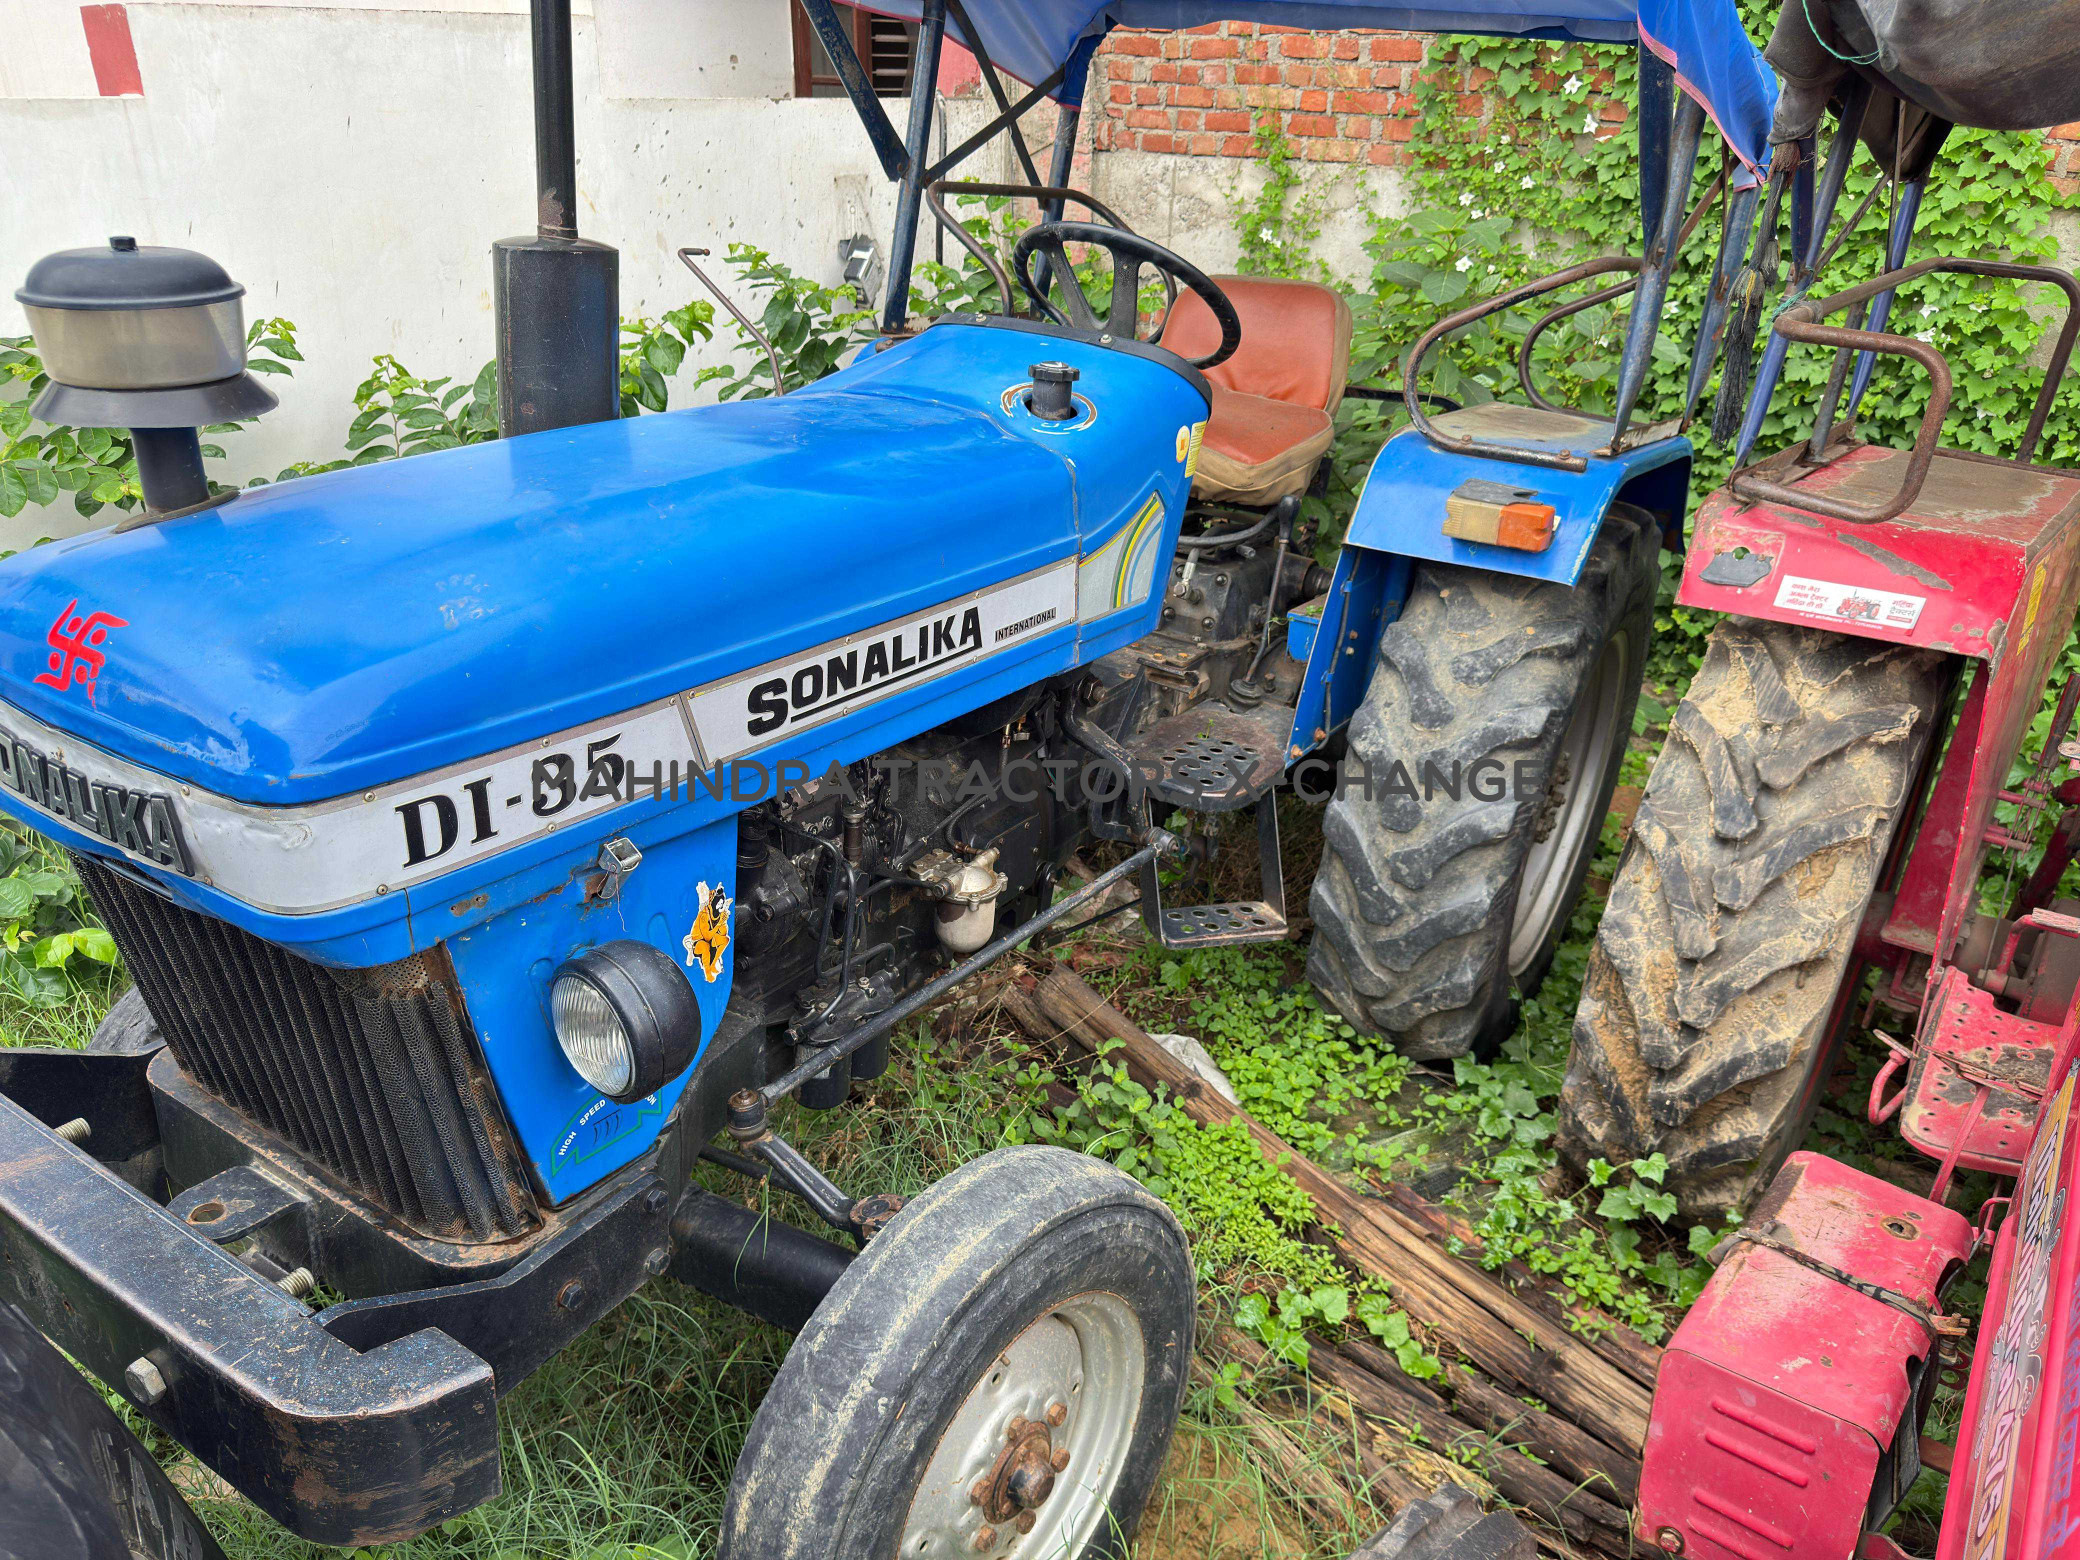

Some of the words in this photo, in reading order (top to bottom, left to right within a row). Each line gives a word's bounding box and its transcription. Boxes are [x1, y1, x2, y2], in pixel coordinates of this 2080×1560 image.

[994, 607, 1057, 643] INTERNATIONAL
[746, 606, 983, 737] SONALIKA
[558, 1131, 577, 1156] HIGH
[579, 1099, 606, 1126] SPEED
